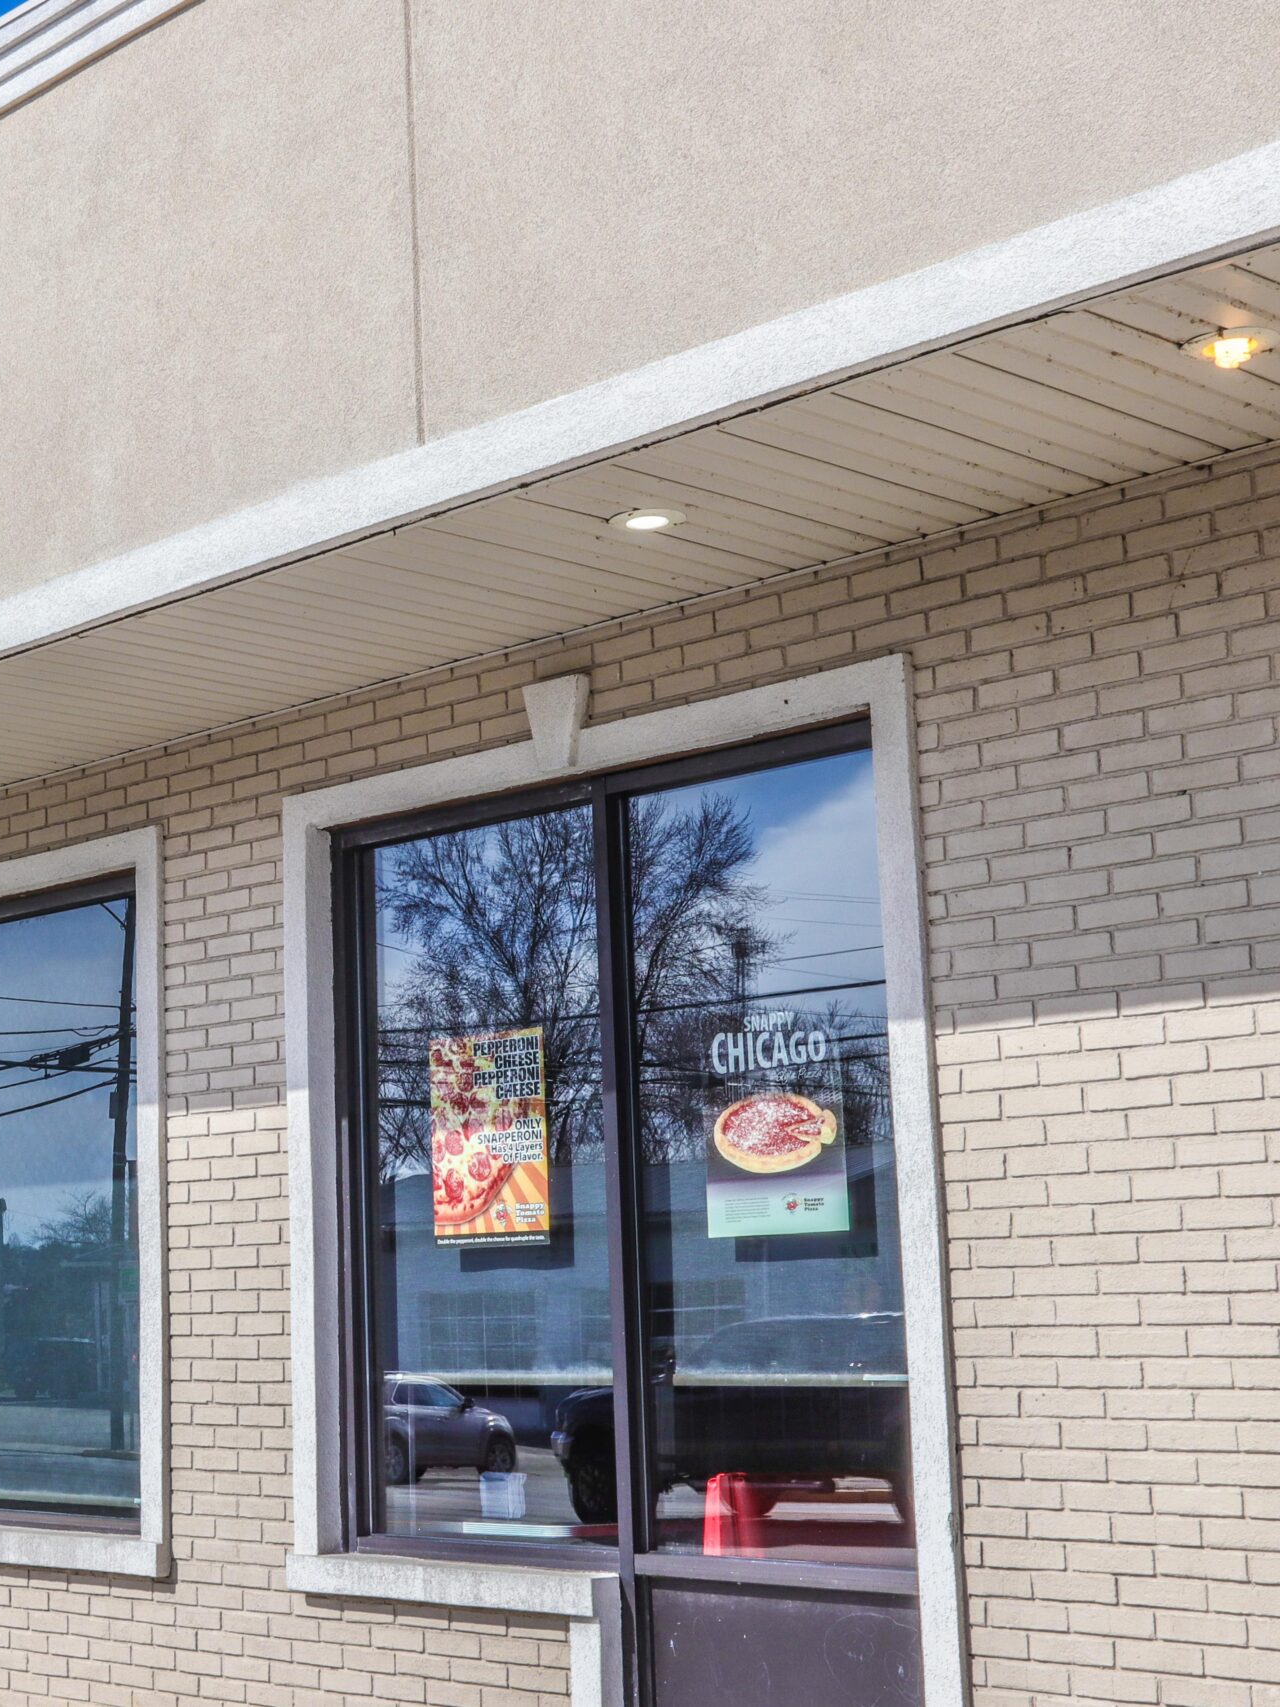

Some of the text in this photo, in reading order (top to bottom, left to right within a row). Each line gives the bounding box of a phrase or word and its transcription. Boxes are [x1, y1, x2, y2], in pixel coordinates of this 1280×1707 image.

[744, 1011, 794, 1031] SNAPPY
[473, 1035, 539, 1057] PEPPERONI
[712, 1031, 826, 1074] CHICAGO
[494, 1051, 539, 1069] CHEESE
[474, 1066, 539, 1086] PEPPERONI
[495, 1081, 540, 1099] CHEESE
[515, 1118, 541, 1130] ONLY
[477, 1130, 542, 1145] SNAPPERONI
[491, 1143, 543, 1153] Has 4 Layers
[503, 1152, 543, 1162] Of Flavor.
